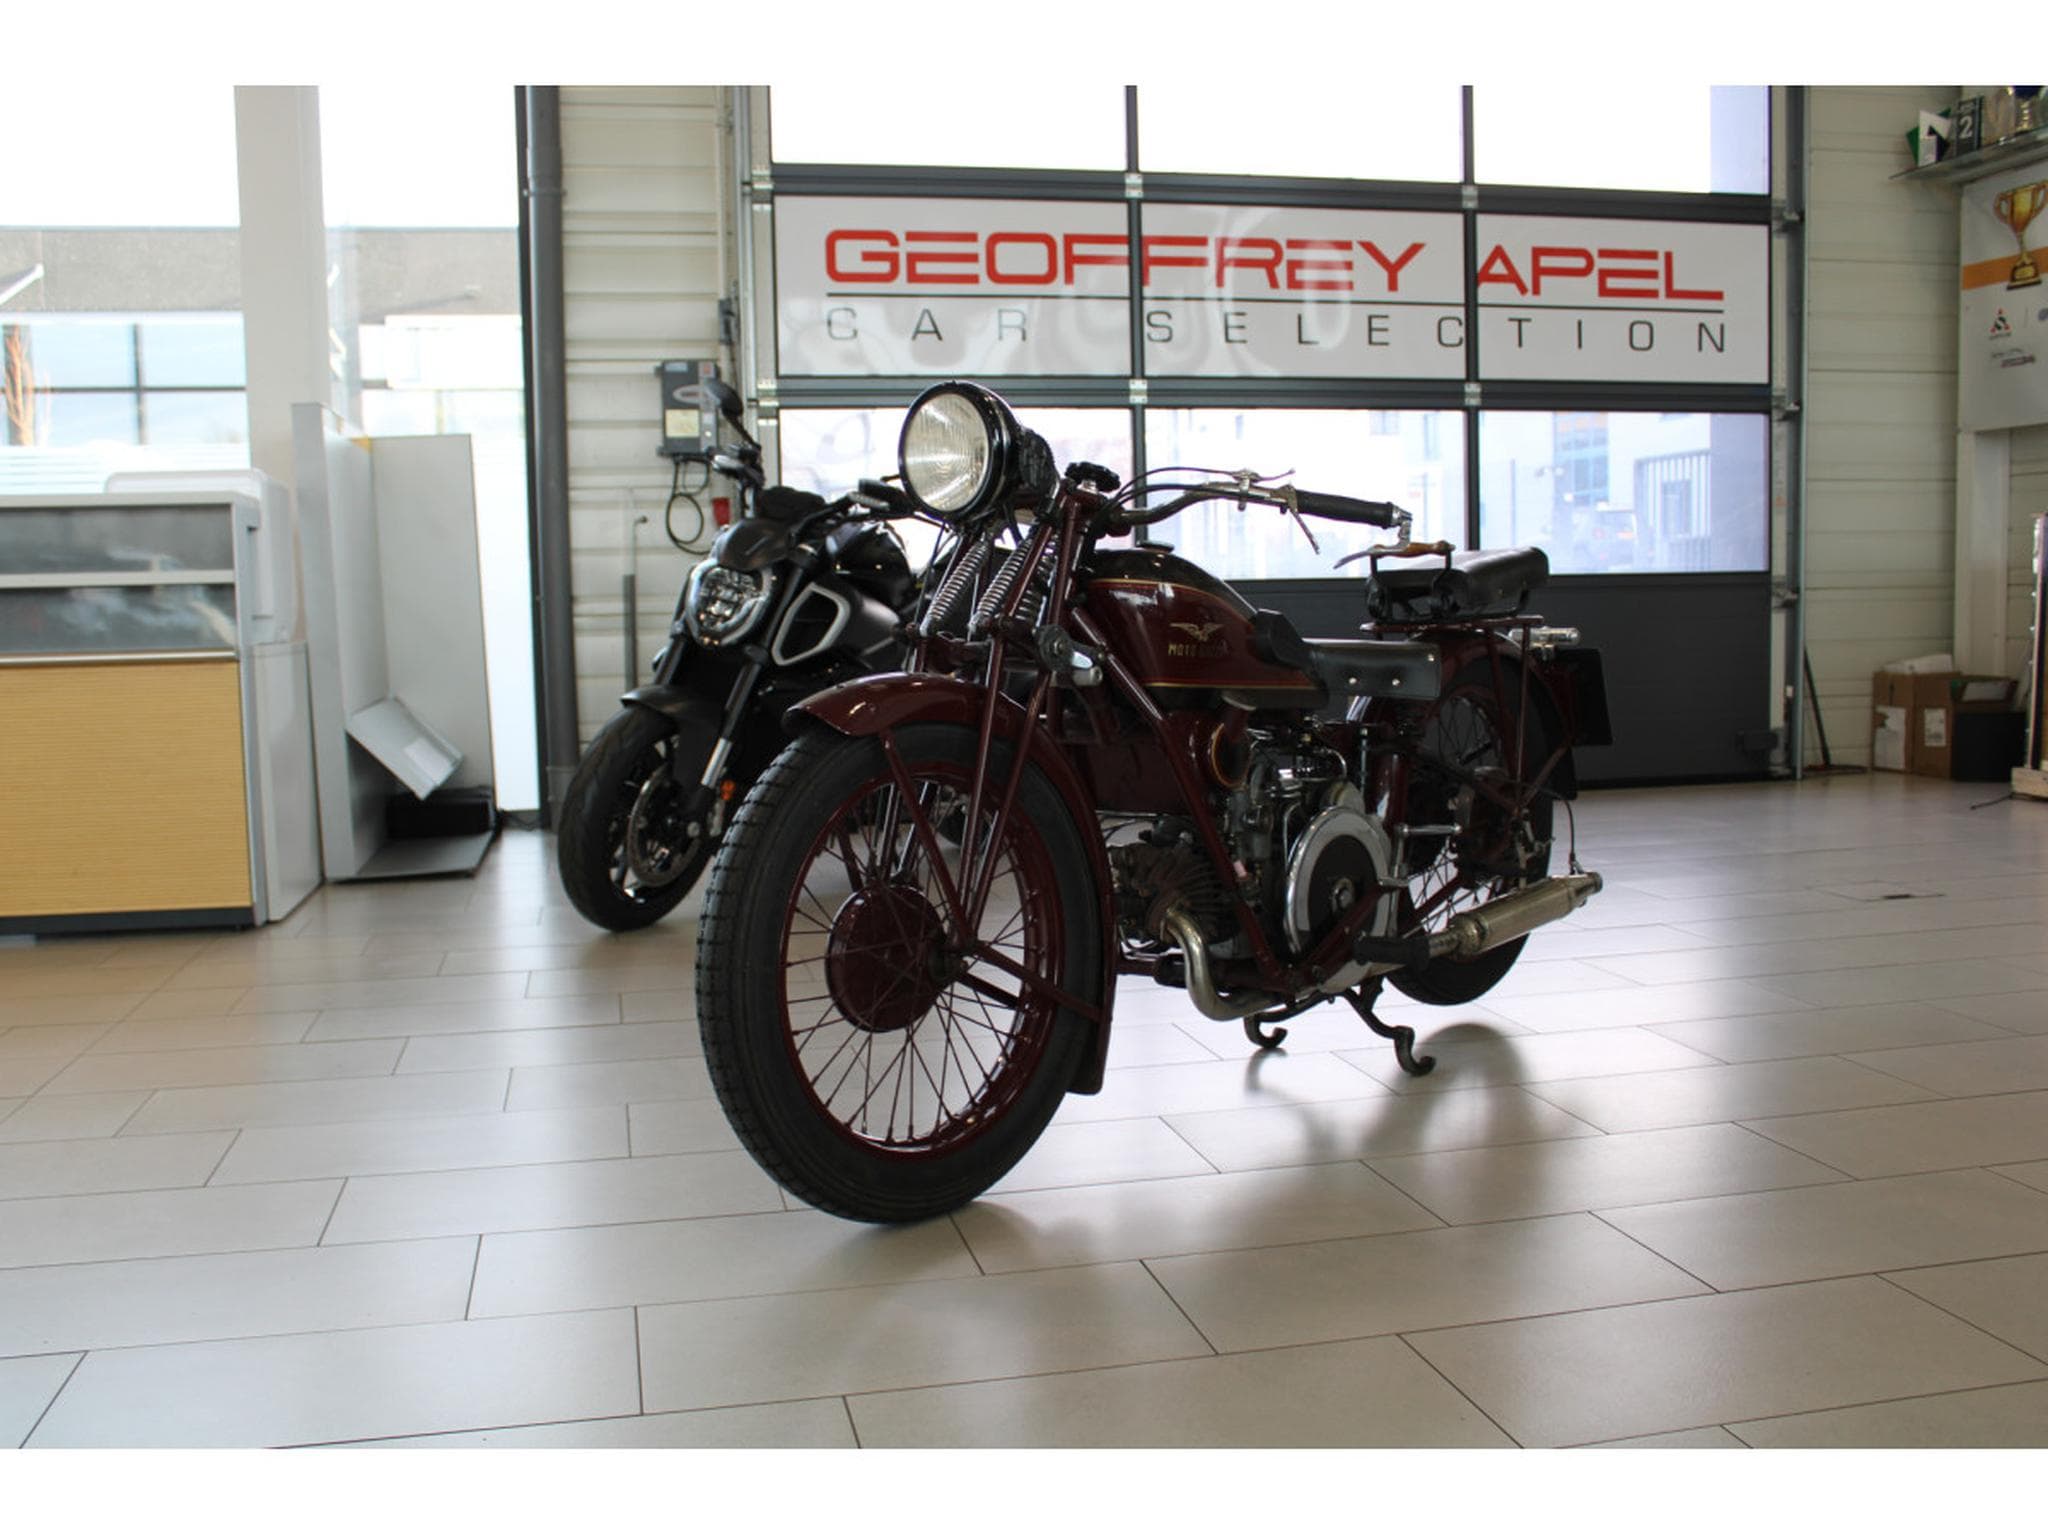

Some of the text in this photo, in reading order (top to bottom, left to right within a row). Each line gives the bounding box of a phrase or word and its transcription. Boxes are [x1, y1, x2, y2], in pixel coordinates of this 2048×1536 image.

[1958, 114, 1974, 139] 2
[825, 228, 1725, 302] GEOFFREY APEL
[826, 307, 1726, 354] CAR SELECTION
